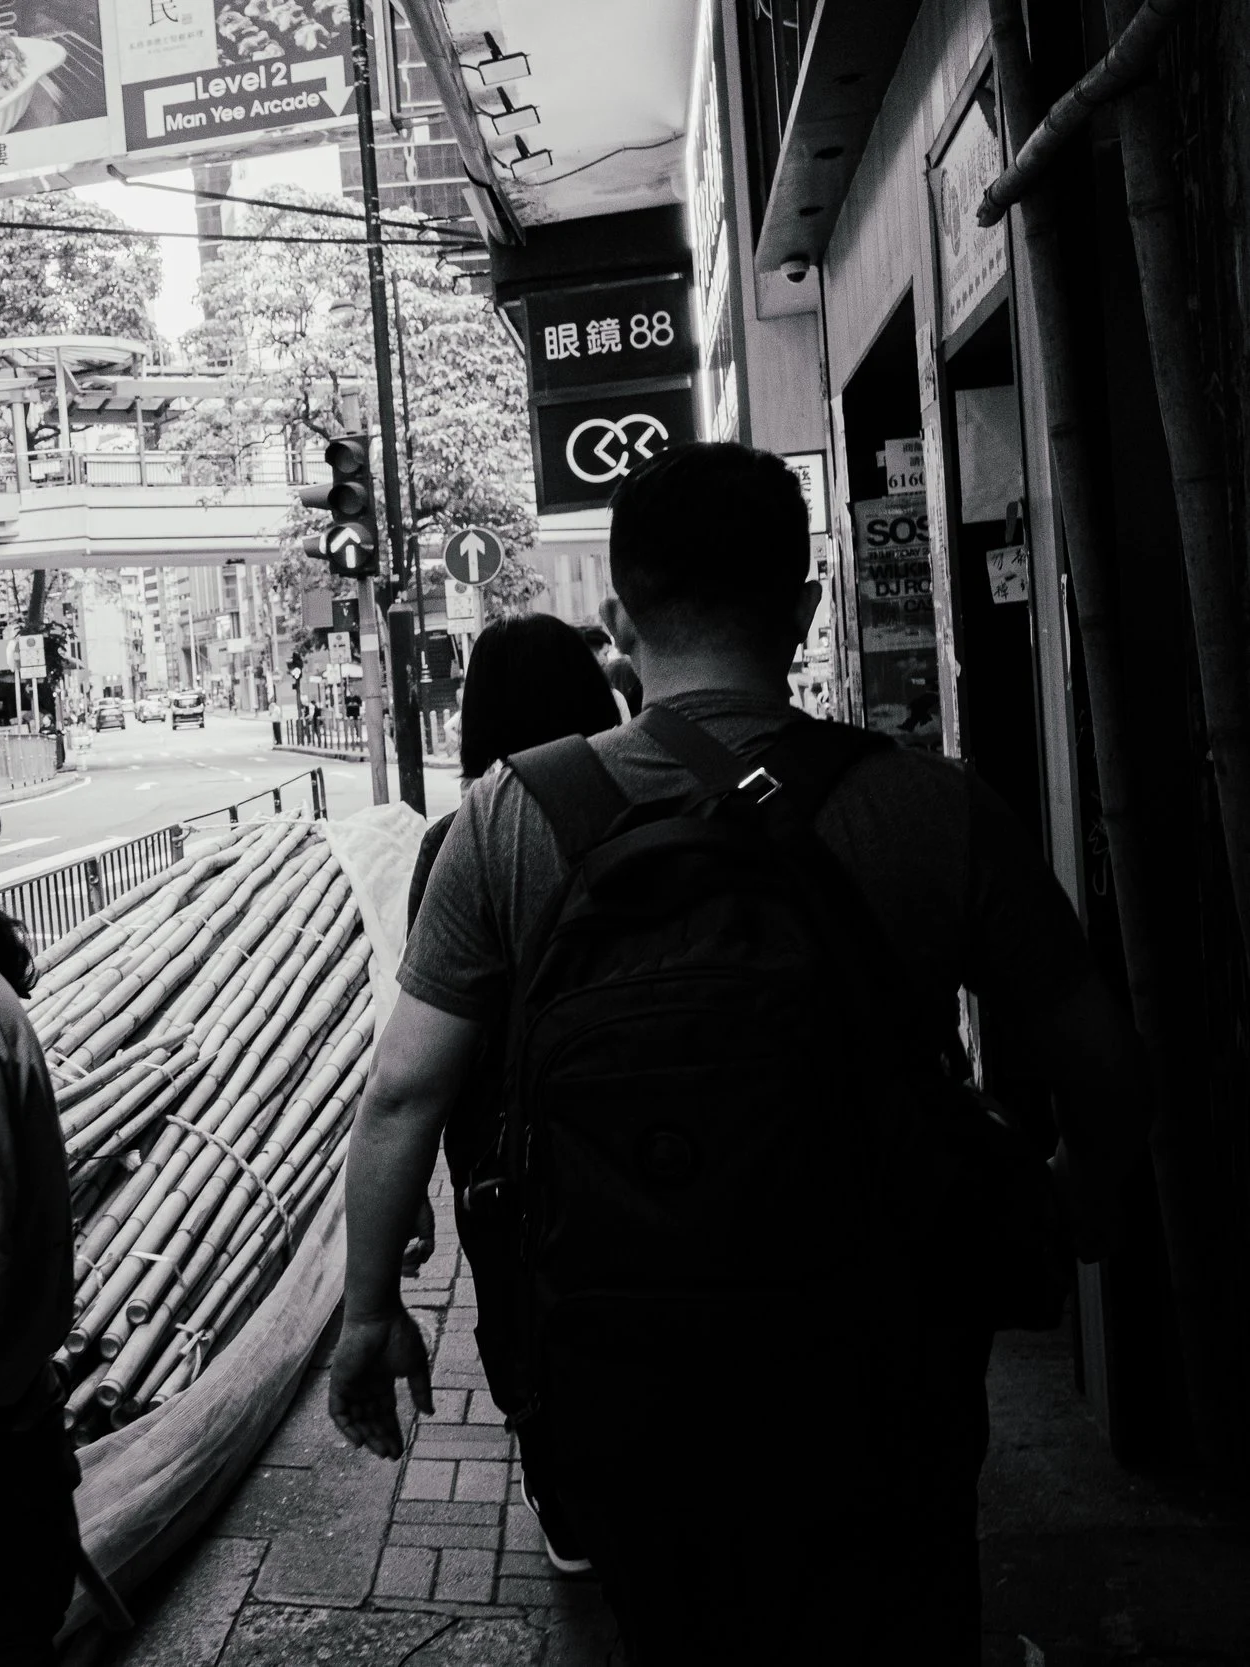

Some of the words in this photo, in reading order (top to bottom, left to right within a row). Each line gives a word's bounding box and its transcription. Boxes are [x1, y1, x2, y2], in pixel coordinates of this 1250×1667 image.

[196, 66, 266, 99] Level
[271, 62, 288, 86] 2
[166, 112, 206, 131] Man
[211, 104, 246, 123] Yee
[250, 92, 320, 117] Arcade
[875, 581, 900, 597] DJ
